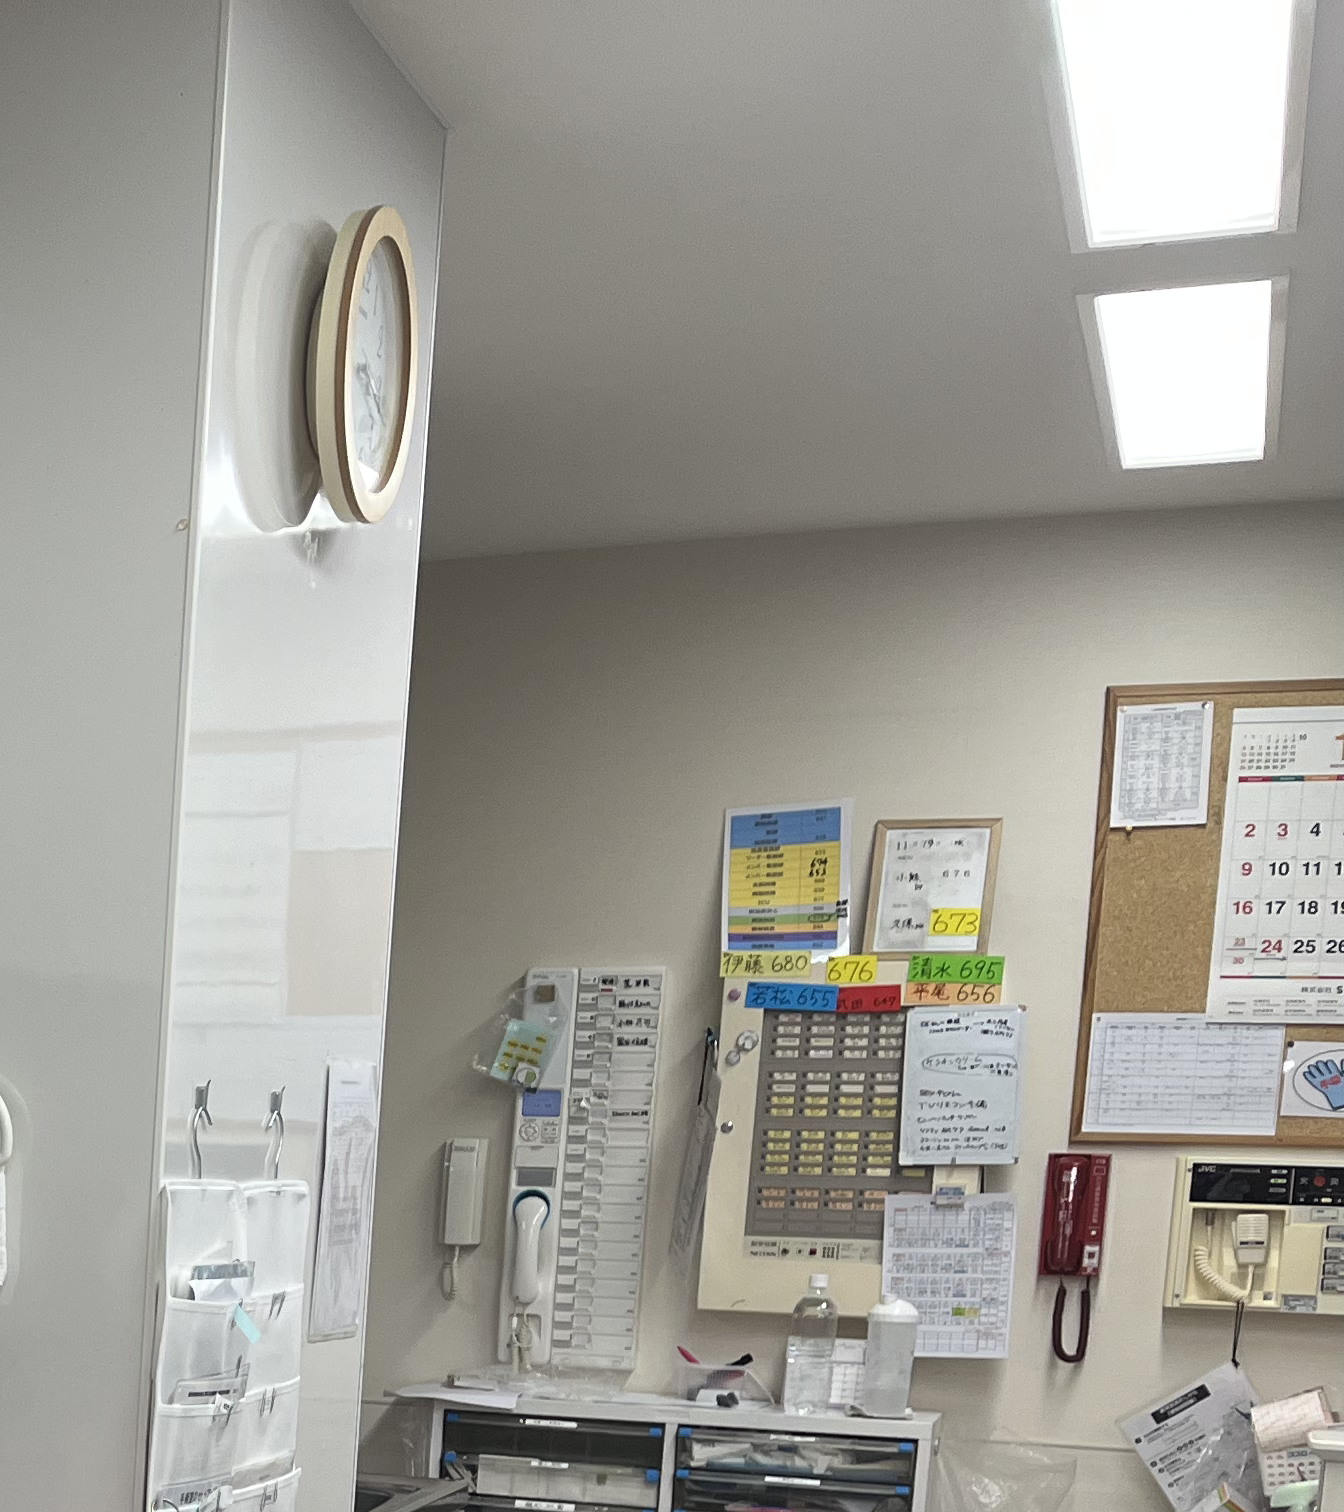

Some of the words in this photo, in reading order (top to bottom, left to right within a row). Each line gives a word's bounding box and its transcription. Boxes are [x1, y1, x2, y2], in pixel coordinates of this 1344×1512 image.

[1244, 823, 1256, 837] 2
[1277, 823, 1289, 837] 3
[1310, 822, 1321, 836] 4
[1241, 862, 1253, 876] 9
[1269, 862, 1290, 876] 10
[1302, 862, 1321, 876] 11
[1233, 901, 1253, 915] 16
[1265, 901, 1286, 915] 17
[1298, 901, 1318, 915] 18
[932, 913, 978, 935] 673
[1261, 940, 1283, 954] 24
[1293, 940, 1316, 954] 25
[723, 951, 764, 974] 伊藤
[771, 955, 808, 971] 680
[827, 961, 873, 982] 676
[912, 955, 952, 980] 清水
[962, 960, 996, 977] 695
[797, 988, 830, 1007] 655
[956, 983, 996, 1003] 656
[1198, 1165, 1216, 1173] JVC
